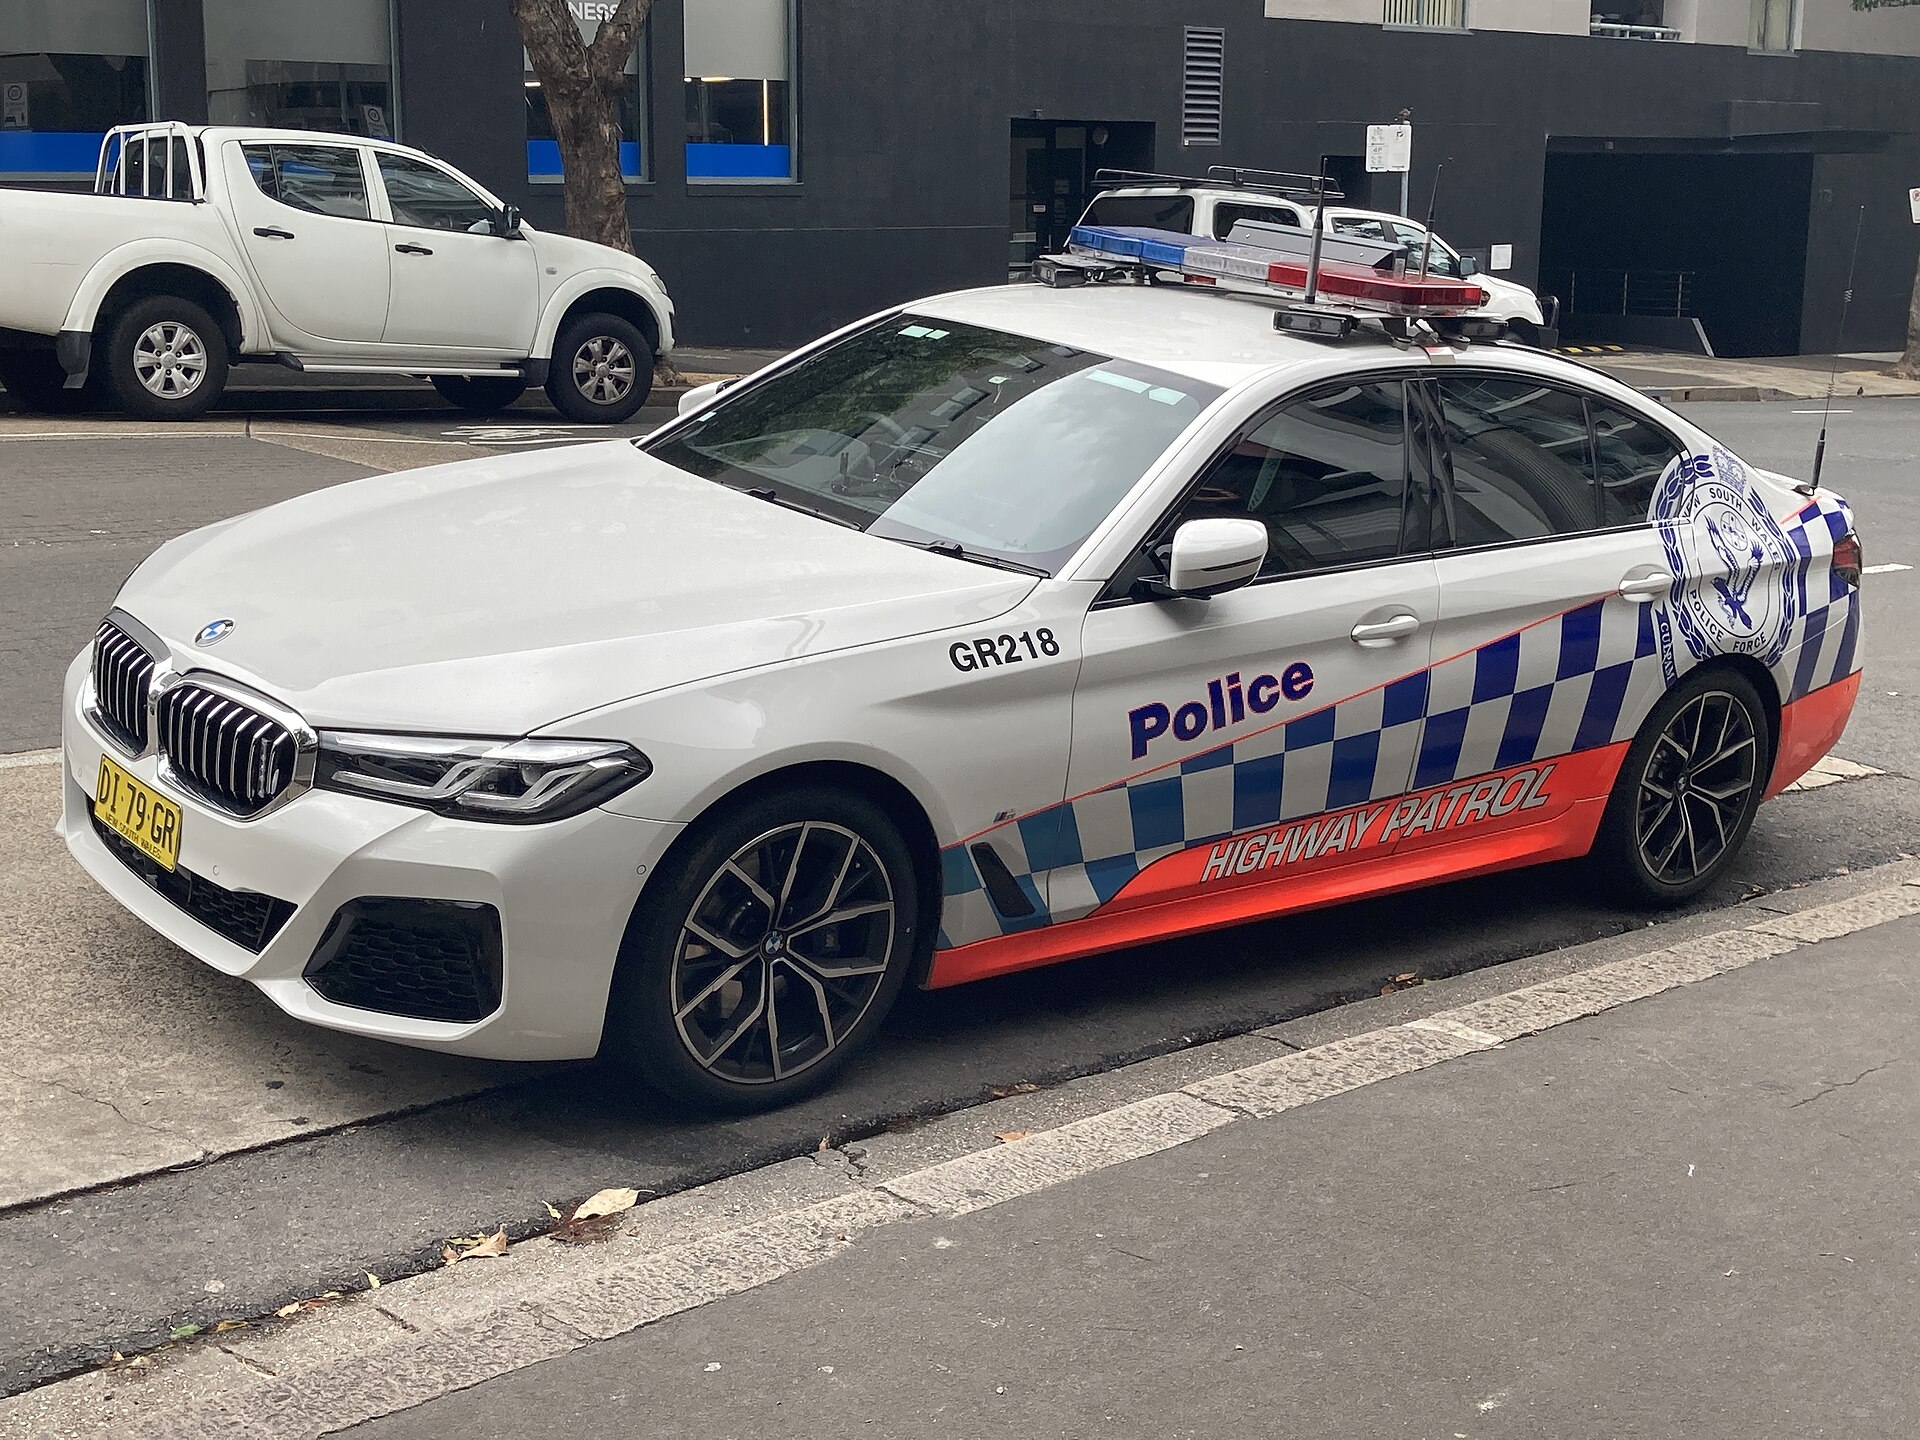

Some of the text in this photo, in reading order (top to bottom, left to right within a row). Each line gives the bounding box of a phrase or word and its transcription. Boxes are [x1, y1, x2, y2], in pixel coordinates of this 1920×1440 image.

[1709, 488, 1742, 512] SOUTH
[1751, 518, 1781, 572] WALES
[949, 627, 1060, 672] GR218
[1690, 588, 1767, 653] POLICE FORCE
[1128, 661, 1315, 761] Police
[119, 820, 139, 844] SOUTH
[140, 837, 162, 860] WALES
[1200, 764, 1556, 882] HIGHWAY PATROL
